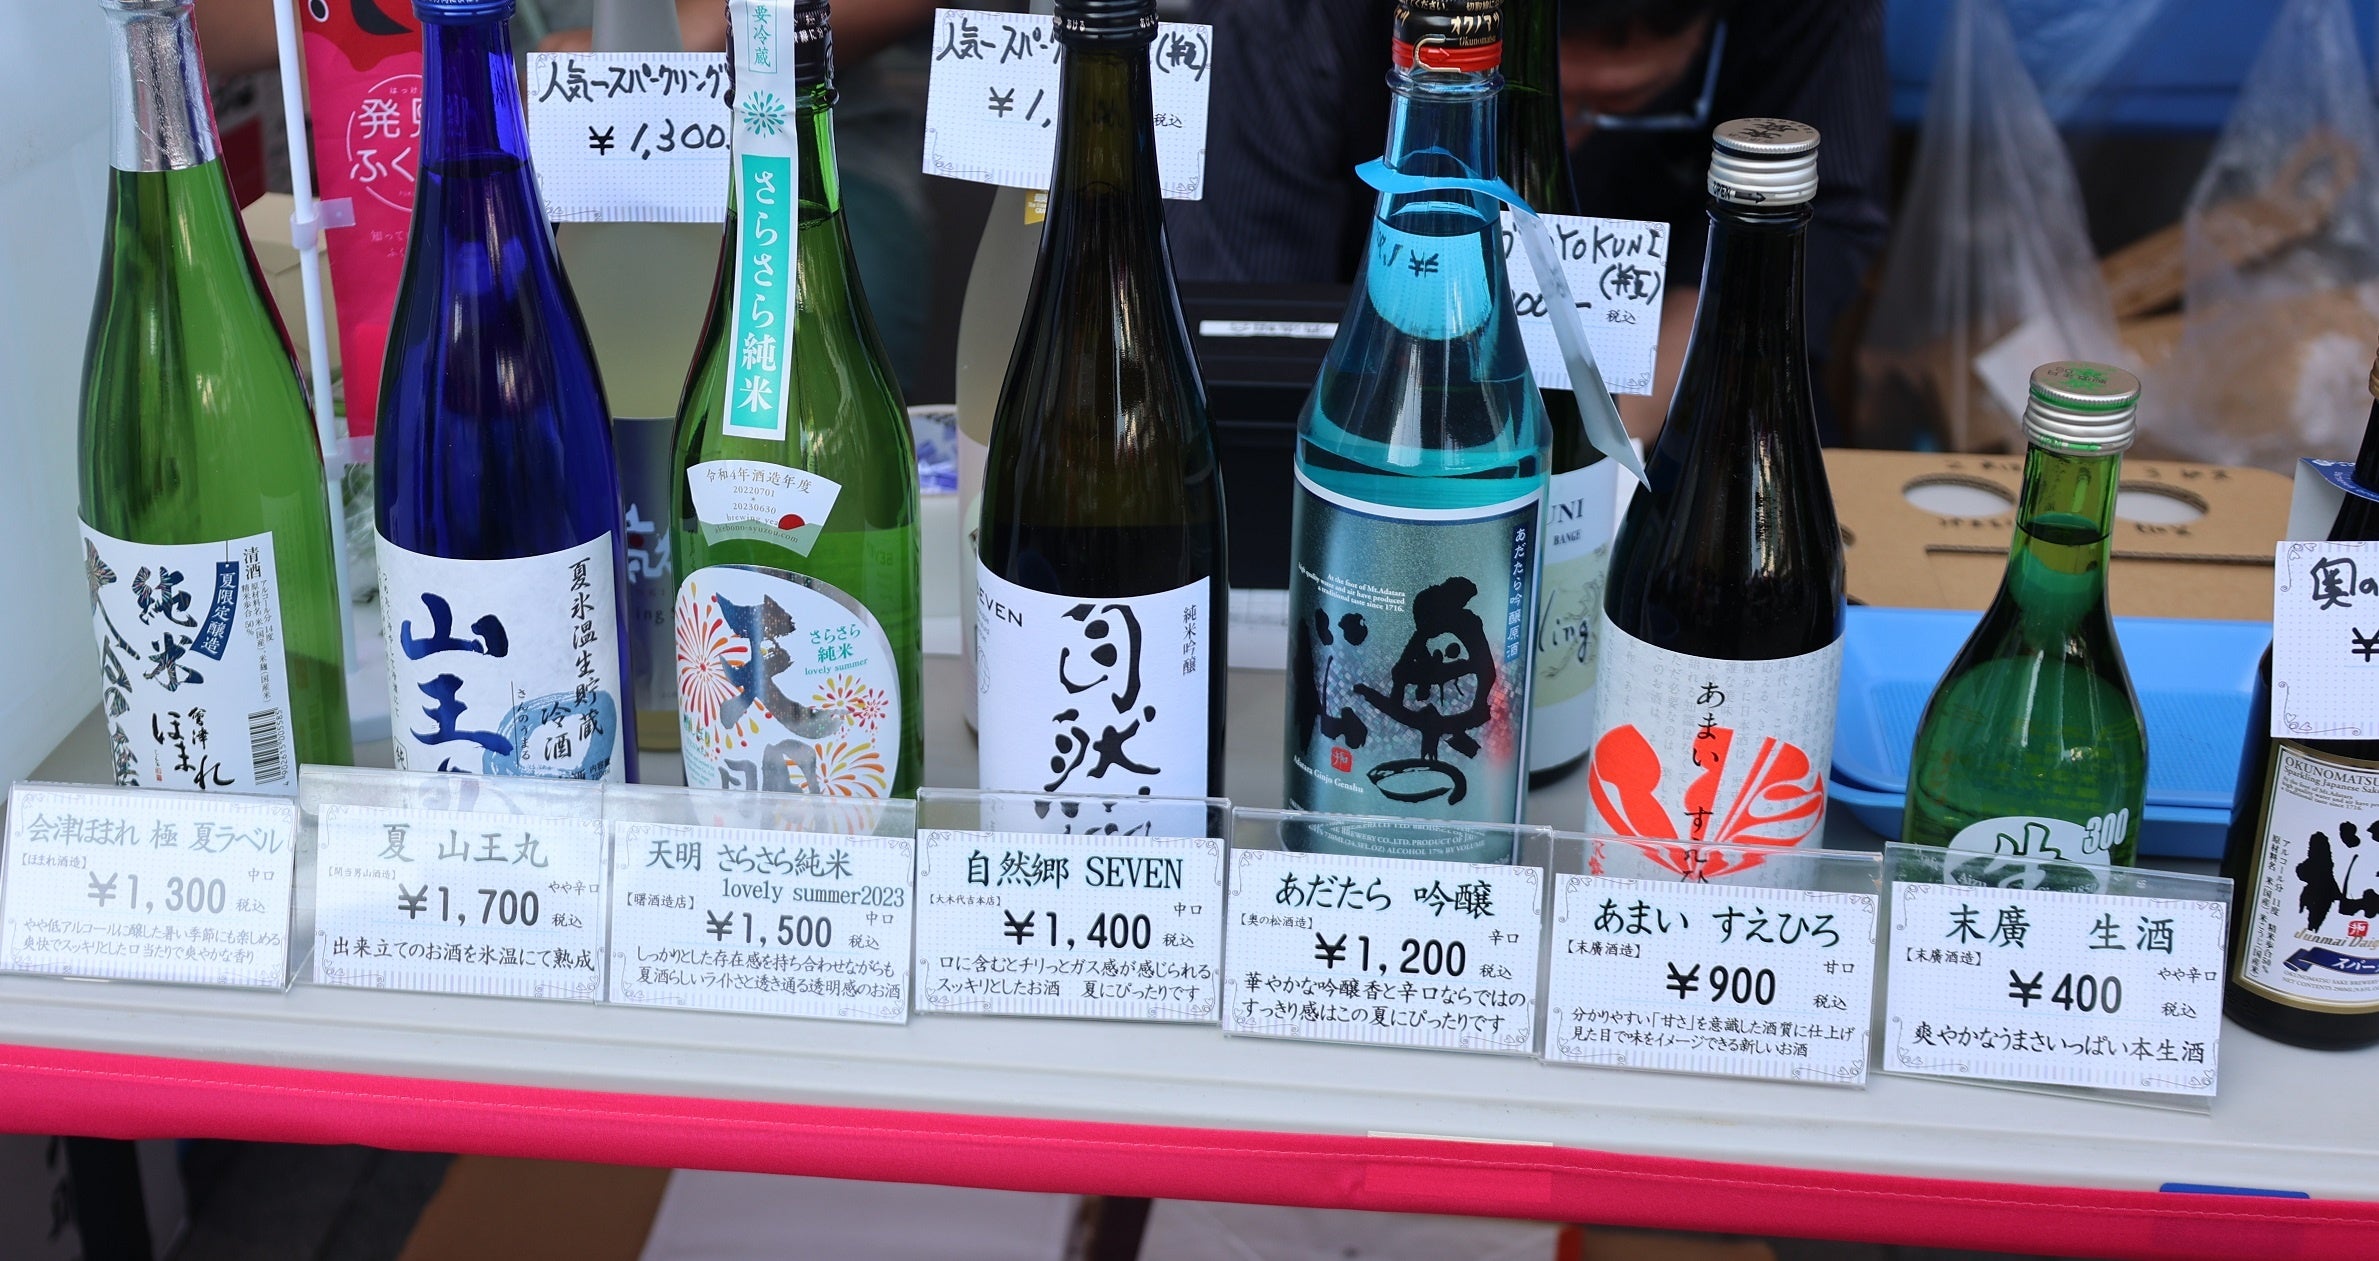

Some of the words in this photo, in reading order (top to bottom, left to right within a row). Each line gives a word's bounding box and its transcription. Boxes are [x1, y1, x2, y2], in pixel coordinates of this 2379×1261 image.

[752, 5, 771, 67] 要冷蔵
[738, 168, 778, 414] さらさら純米
[1606, 309, 1636, 325] 税込
[706, 466, 813, 495] 令和4年酒造年度
[733, 486, 775, 498] 20220701
[764, 517, 779, 527] yea
[243, 546, 262, 580] 清酒
[1505, 526, 1527, 659] あだたら吟醸原酒
[131, 566, 205, 692] 純米
[809, 623, 862, 646] さらさら
[1182, 603, 1197, 677] 純米吟醸
[804, 666, 833, 677] lovely
[833, 657, 869, 674] summer
[817, 642, 854, 664] 純米
[517, 688, 531, 760] さんのうまる
[540, 701, 571, 761] 冷酒
[1692, 681, 1726, 768] あまい
[2283, 765, 2321, 786] Sparkling
[2321, 779, 2360, 793] Japanese
[27, 812, 140, 846] 会津ほまれ
[150, 819, 178, 850] 極
[188, 821, 284, 855] 夏ラベル
[378, 822, 415, 862] 夏
[438, 829, 549, 868] 山王丸
[2082, 807, 2130, 855] 300
[646, 839, 702, 872] 天明
[717, 843, 854, 880] さらさら純米
[967, 849, 1070, 890] 自然郷
[1085, 855, 1184, 889] SEVEN
[248, 867, 275, 883] 中口
[548, 880, 600, 896] やや辛口
[235, 898, 267, 913] 税込
[722, 878, 784, 902] lovely
[792, 885, 905, 908] summer2023
[1275, 870, 1392, 911] あだたら
[1413, 879, 1495, 919] 吟醸
[551, 912, 584, 929] 税込
[865, 910, 895, 927] 中口
[1173, 901, 1203, 918] 中口
[1593, 897, 1690, 936] あまい
[1712, 905, 1841, 950] すえひろ
[848, 934, 881, 951] 税込
[1161, 932, 1195, 949] 税込
[1488, 928, 1520, 947] 辛口
[1945, 902, 2032, 949] 末廣
[2089, 912, 2176, 955] 生酒
[333, 935, 596, 972] 出来立てのお酒を氷温にて熟成
[636, 945, 896, 977] しっかりとした存在感を持ち合わせながらも
[939, 953, 1212, 980] 口に含むとチリっとガス感が感じられる
[1823, 959, 1856, 976] 甘口
[637, 965, 901, 1000] 夏酒らしいライトさと透き通る透明感のお酒
[1479, 963, 1514, 981] 税込
[2157, 966, 2218, 983] やや辛口
[937, 976, 1061, 998] スッキリとしたお酒
[1081, 979, 1201, 1003] 夏にぴったりです
[1244, 970, 1527, 1008] 華やかな吟醸香と辛口ならではの
[1812, 994, 1849, 1011] 税込
[1241, 996, 1506, 1035] すっきり感はこの夏にぴったりです
[2161, 1001, 2198, 1020] 税込
[1570, 1024, 1809, 1058] 見た目で味をイメージできる新しいお酒
[1911, 1020, 2206, 1065] 爽やかなうまさいっぱい本生酒
